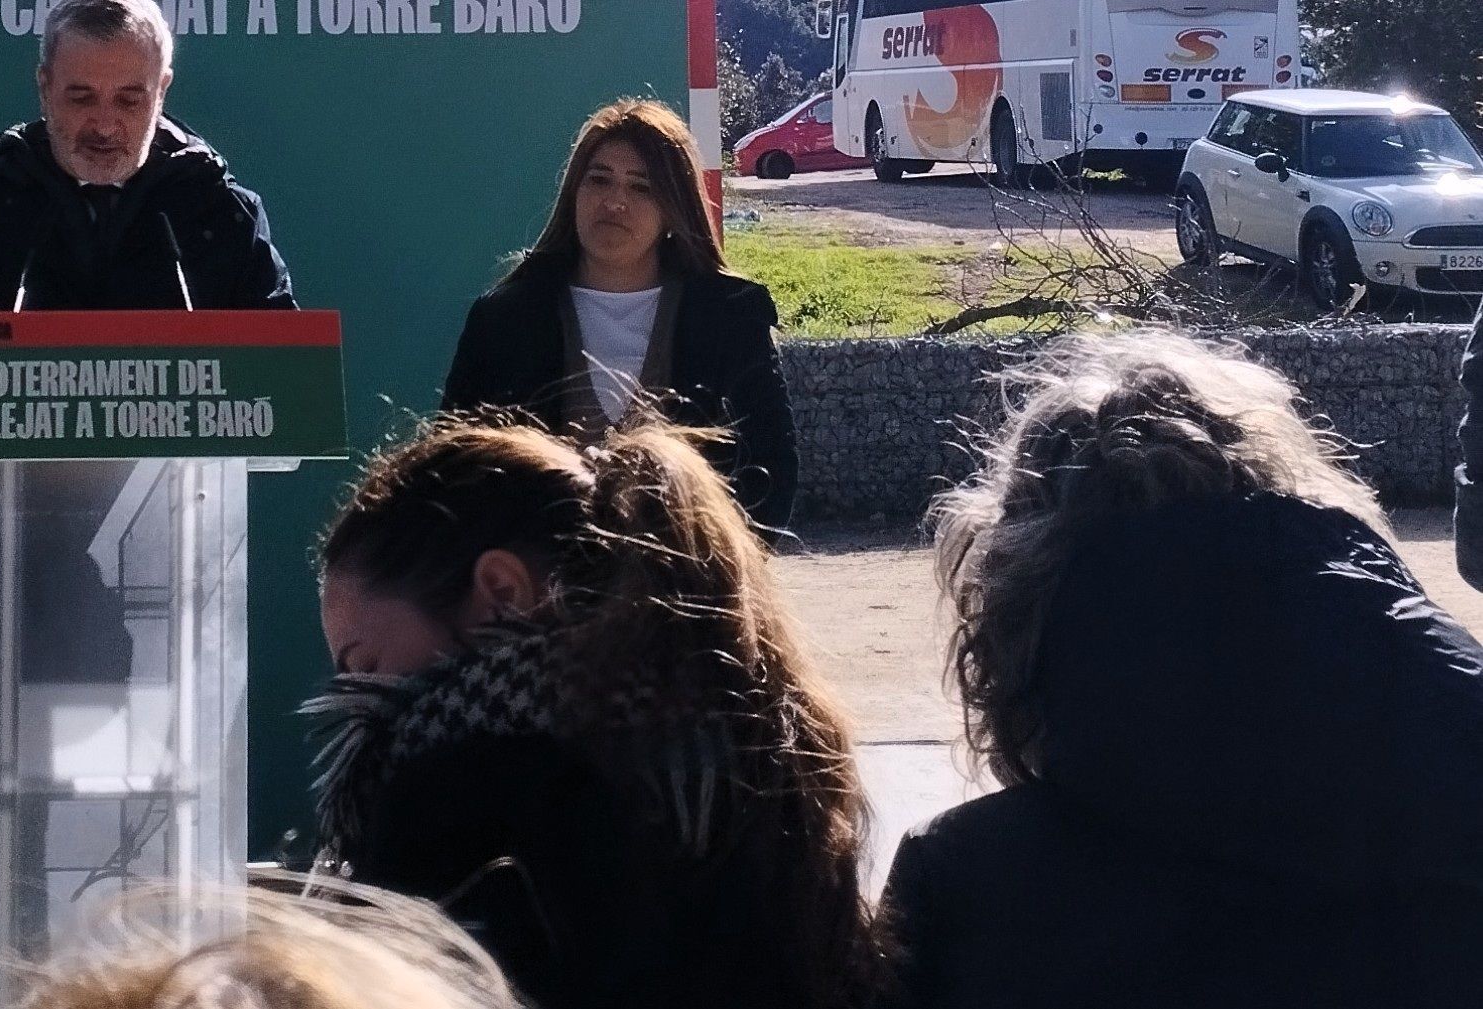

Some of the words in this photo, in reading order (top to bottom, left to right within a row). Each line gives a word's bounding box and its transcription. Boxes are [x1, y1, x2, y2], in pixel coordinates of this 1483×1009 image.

[882, 20, 944, 60] serrat
[1142, 65, 1246, 83] serrat
[1450, 255, 1483, 268] 8226
[178, 359, 227, 395] DEL
[76, 402, 94, 439] A
[100, 401, 191, 438] TORRE
[198, 397, 274, 438] BARÓ
